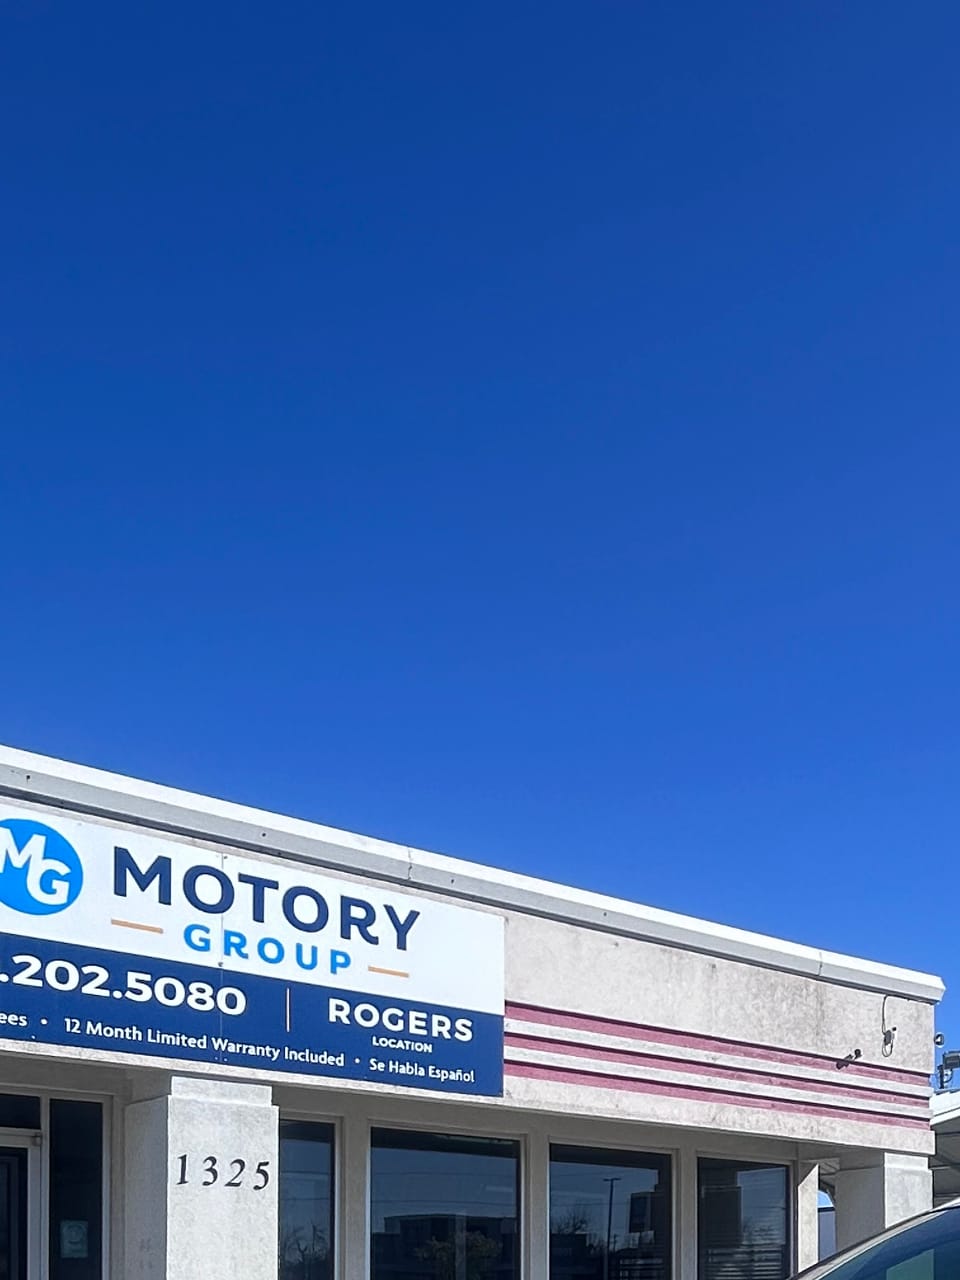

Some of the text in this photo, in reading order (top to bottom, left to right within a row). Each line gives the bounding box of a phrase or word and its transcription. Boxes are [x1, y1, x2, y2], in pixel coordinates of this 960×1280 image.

[0, 826, 71, 905] MG
[113, 846, 420, 951] MOTORY
[183, 923, 352, 975] GROUP
[328, 998, 473, 1042] ROGERS
[372, 1036, 433, 1053] LOCATION
[64, 1018, 81, 1034] 12
[86, 1021, 142, 1041] Month
[147, 1029, 207, 1049] Limited
[211, 1037, 280, 1061] Warranty
[284, 1046, 345, 1067] Included
[369, 1058, 385, 1072] Se
[388, 1060, 425, 1077] Habla
[428, 1065, 475, 1083] Español
[176, 1154, 270, 1190] 1325
